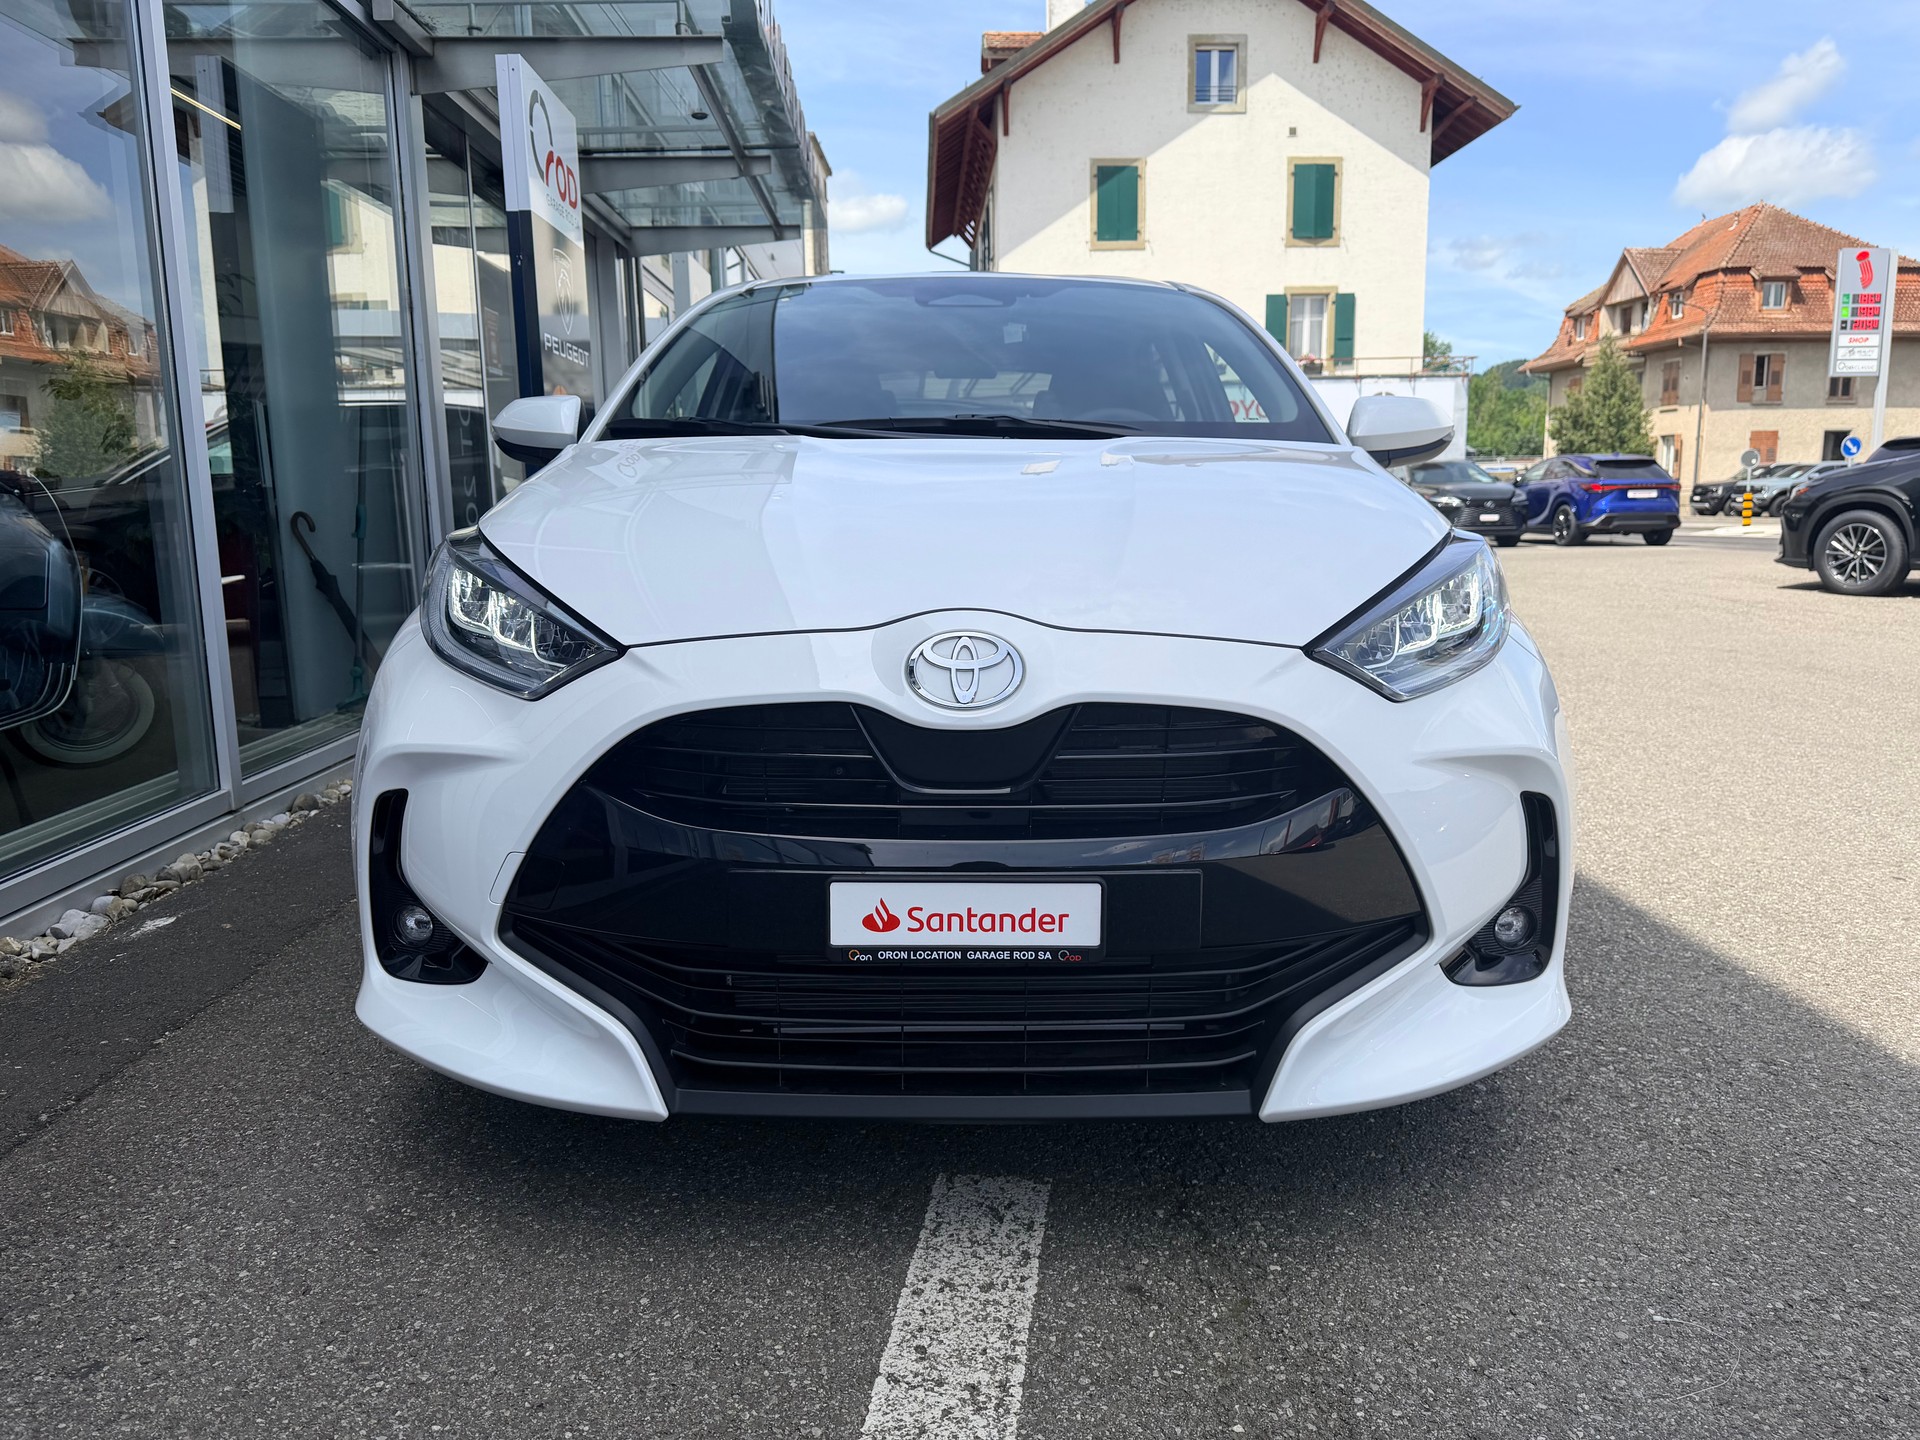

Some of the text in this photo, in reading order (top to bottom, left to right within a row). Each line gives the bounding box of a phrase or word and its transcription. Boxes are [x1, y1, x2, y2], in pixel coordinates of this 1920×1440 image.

[544, 333, 589, 368] PEUGEOT
[907, 906, 1069, 933] Santander
[878, 951, 908, 960] ORON
[910, 951, 962, 960] LOCATION
[966, 951, 1011, 960] GARAGE
[1013, 951, 1035, 960] ROD
[1038, 951, 1052, 960] SA
